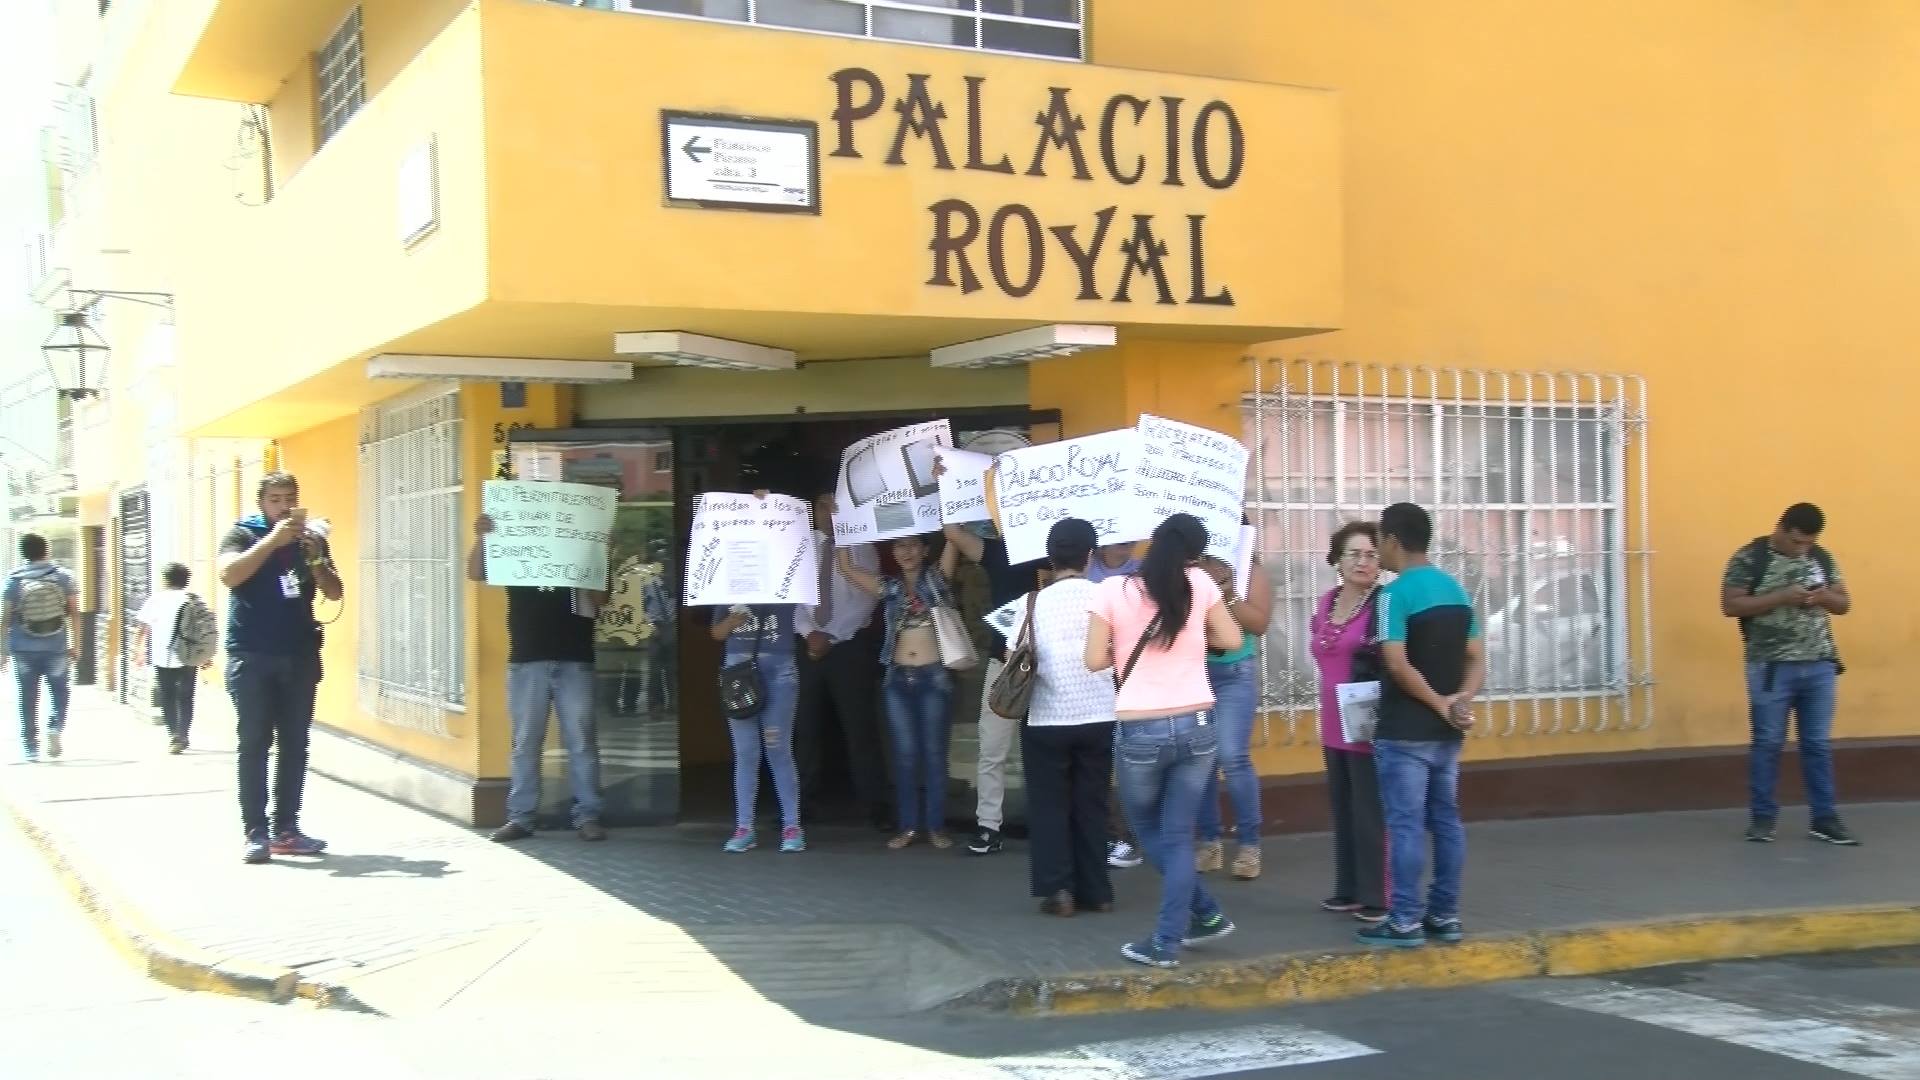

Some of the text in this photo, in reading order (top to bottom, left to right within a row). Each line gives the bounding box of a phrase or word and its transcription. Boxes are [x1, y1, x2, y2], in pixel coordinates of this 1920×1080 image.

[828, 67, 1246, 189] PALACIO
[925, 199, 1236, 305] ROYAL
[998, 445, 1127, 492] PALACIO ROYAL
[487, 486, 606, 510] NO PERMITIREMOS
[945, 496, 984, 515] BASTA
[1165, 490, 1175, 500] la
[1180, 495, 1215, 510] misma
[488, 508, 575, 523] QUE VIVAN DE
[713, 519, 755, 531] quieren
[1009, 512, 1027, 527] LO
[1037, 506, 1070, 520] QUE
[490, 544, 551, 559] EXIGIMOS
